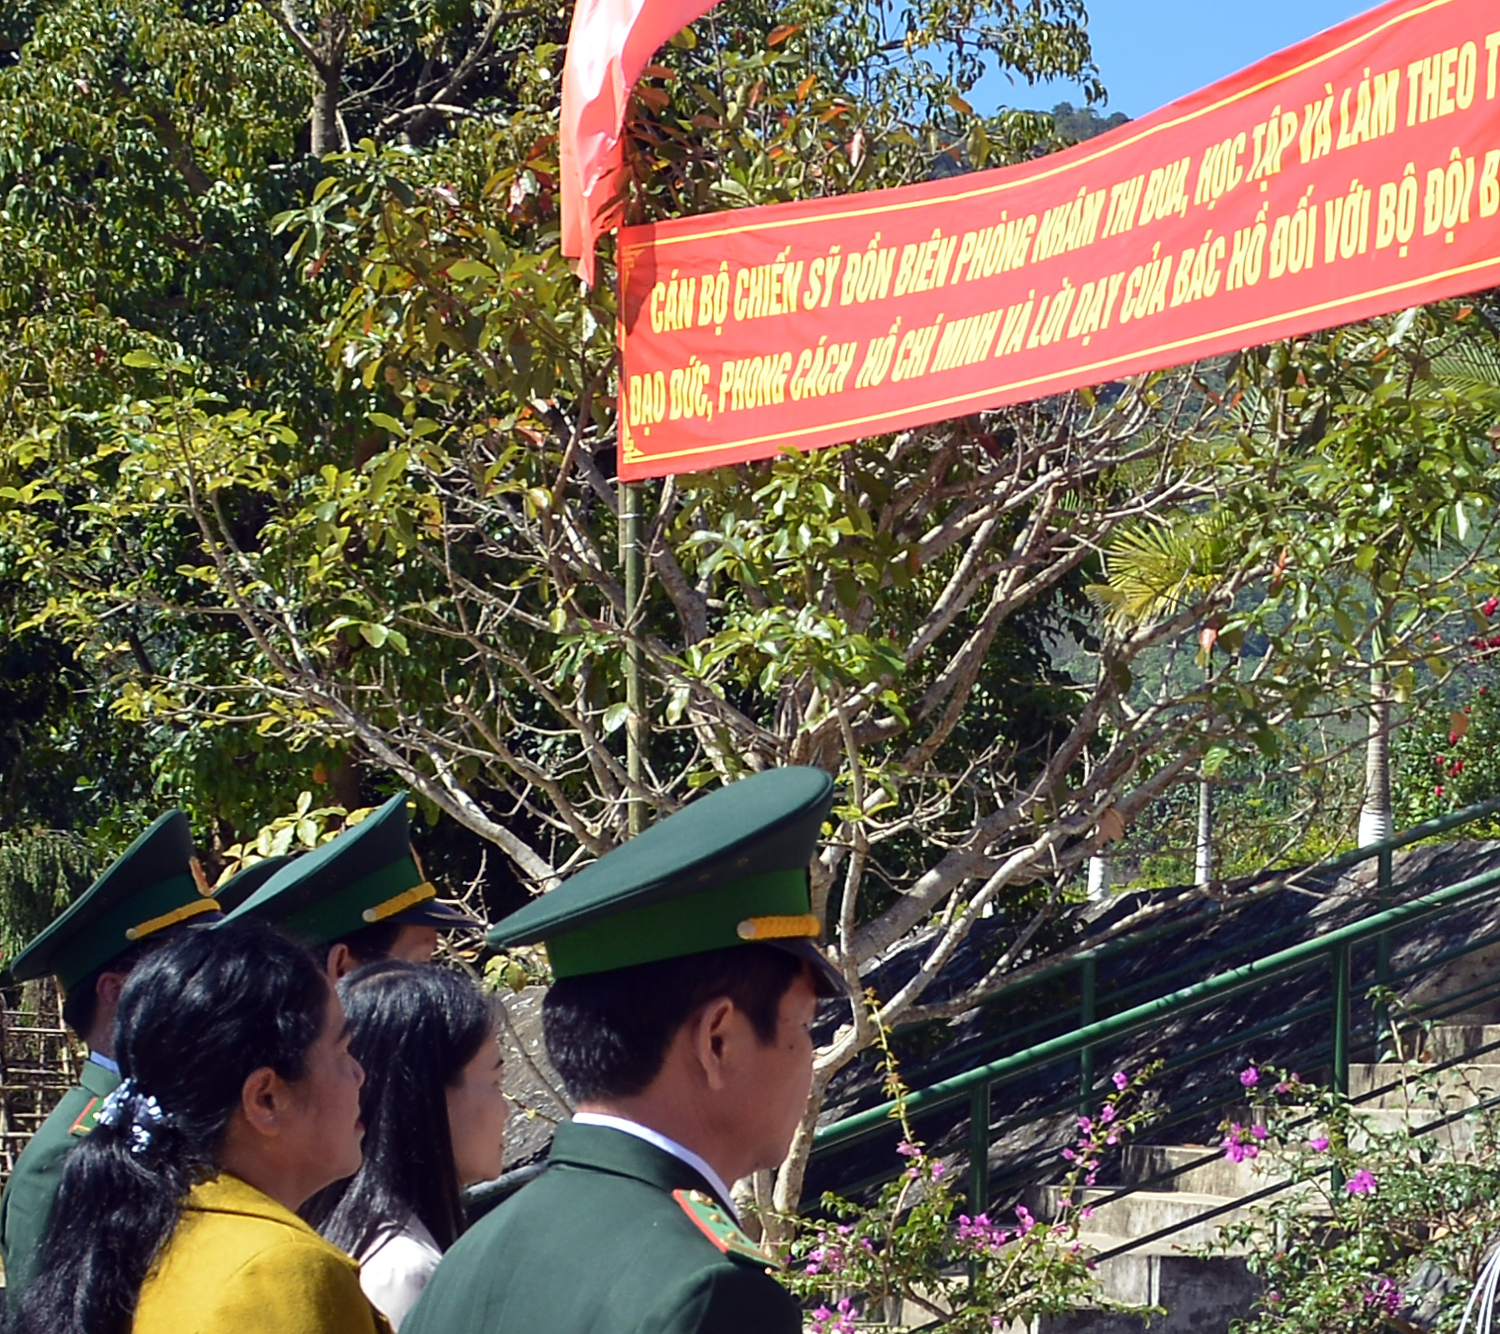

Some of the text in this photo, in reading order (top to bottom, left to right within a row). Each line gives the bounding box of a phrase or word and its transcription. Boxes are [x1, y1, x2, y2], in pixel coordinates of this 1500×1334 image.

[629, 370, 666, 435] ĐẠO
[669, 355, 713, 422] ĐỨC,
[719, 352, 792, 413] PHONG
[790, 335, 857, 401] CÁCH
[855, 316, 901, 389] HỒ
[891, 313, 944, 383] CHÍ
[934, 308, 1002, 374] MINH
[995, 290, 1036, 358] VÀ
[1026, 278, 1072, 349] LỜI
[1067, 271, 1125, 346] DẠY
[1120, 241, 1171, 325] CỦA
[1169, 229, 1226, 308] BÁC
[1226, 201, 1269, 291] HỒ
[1268, 184, 1318, 279] ĐỐI
[1324, 178, 1371, 264] VỚI
[1375, 162, 1418, 258] BỘ
[1423, 146, 1475, 244] ĐỘI
[650, 269, 694, 333] CÁN
[698, 261, 730, 336] BỘ
[734, 246, 803, 321] CHIẾN
[803, 245, 841, 310] SỸ
[840, 232, 897, 306] ĐỒN
[894, 229, 957, 298] BIÊN
[953, 211, 1037, 288] PHÒNG
[1032, 186, 1102, 262] NHÂM
[1101, 174, 1145, 239] THI
[1138, 157, 1191, 227] ĐUA,
[1194, 132, 1247, 210] HỌC
[1246, 105, 1298, 192] TẬP
[1299, 83, 1335, 163] VÀ
[1336, 67, 1400, 150] LÀM
[1406, 41, 1477, 127] THEO
